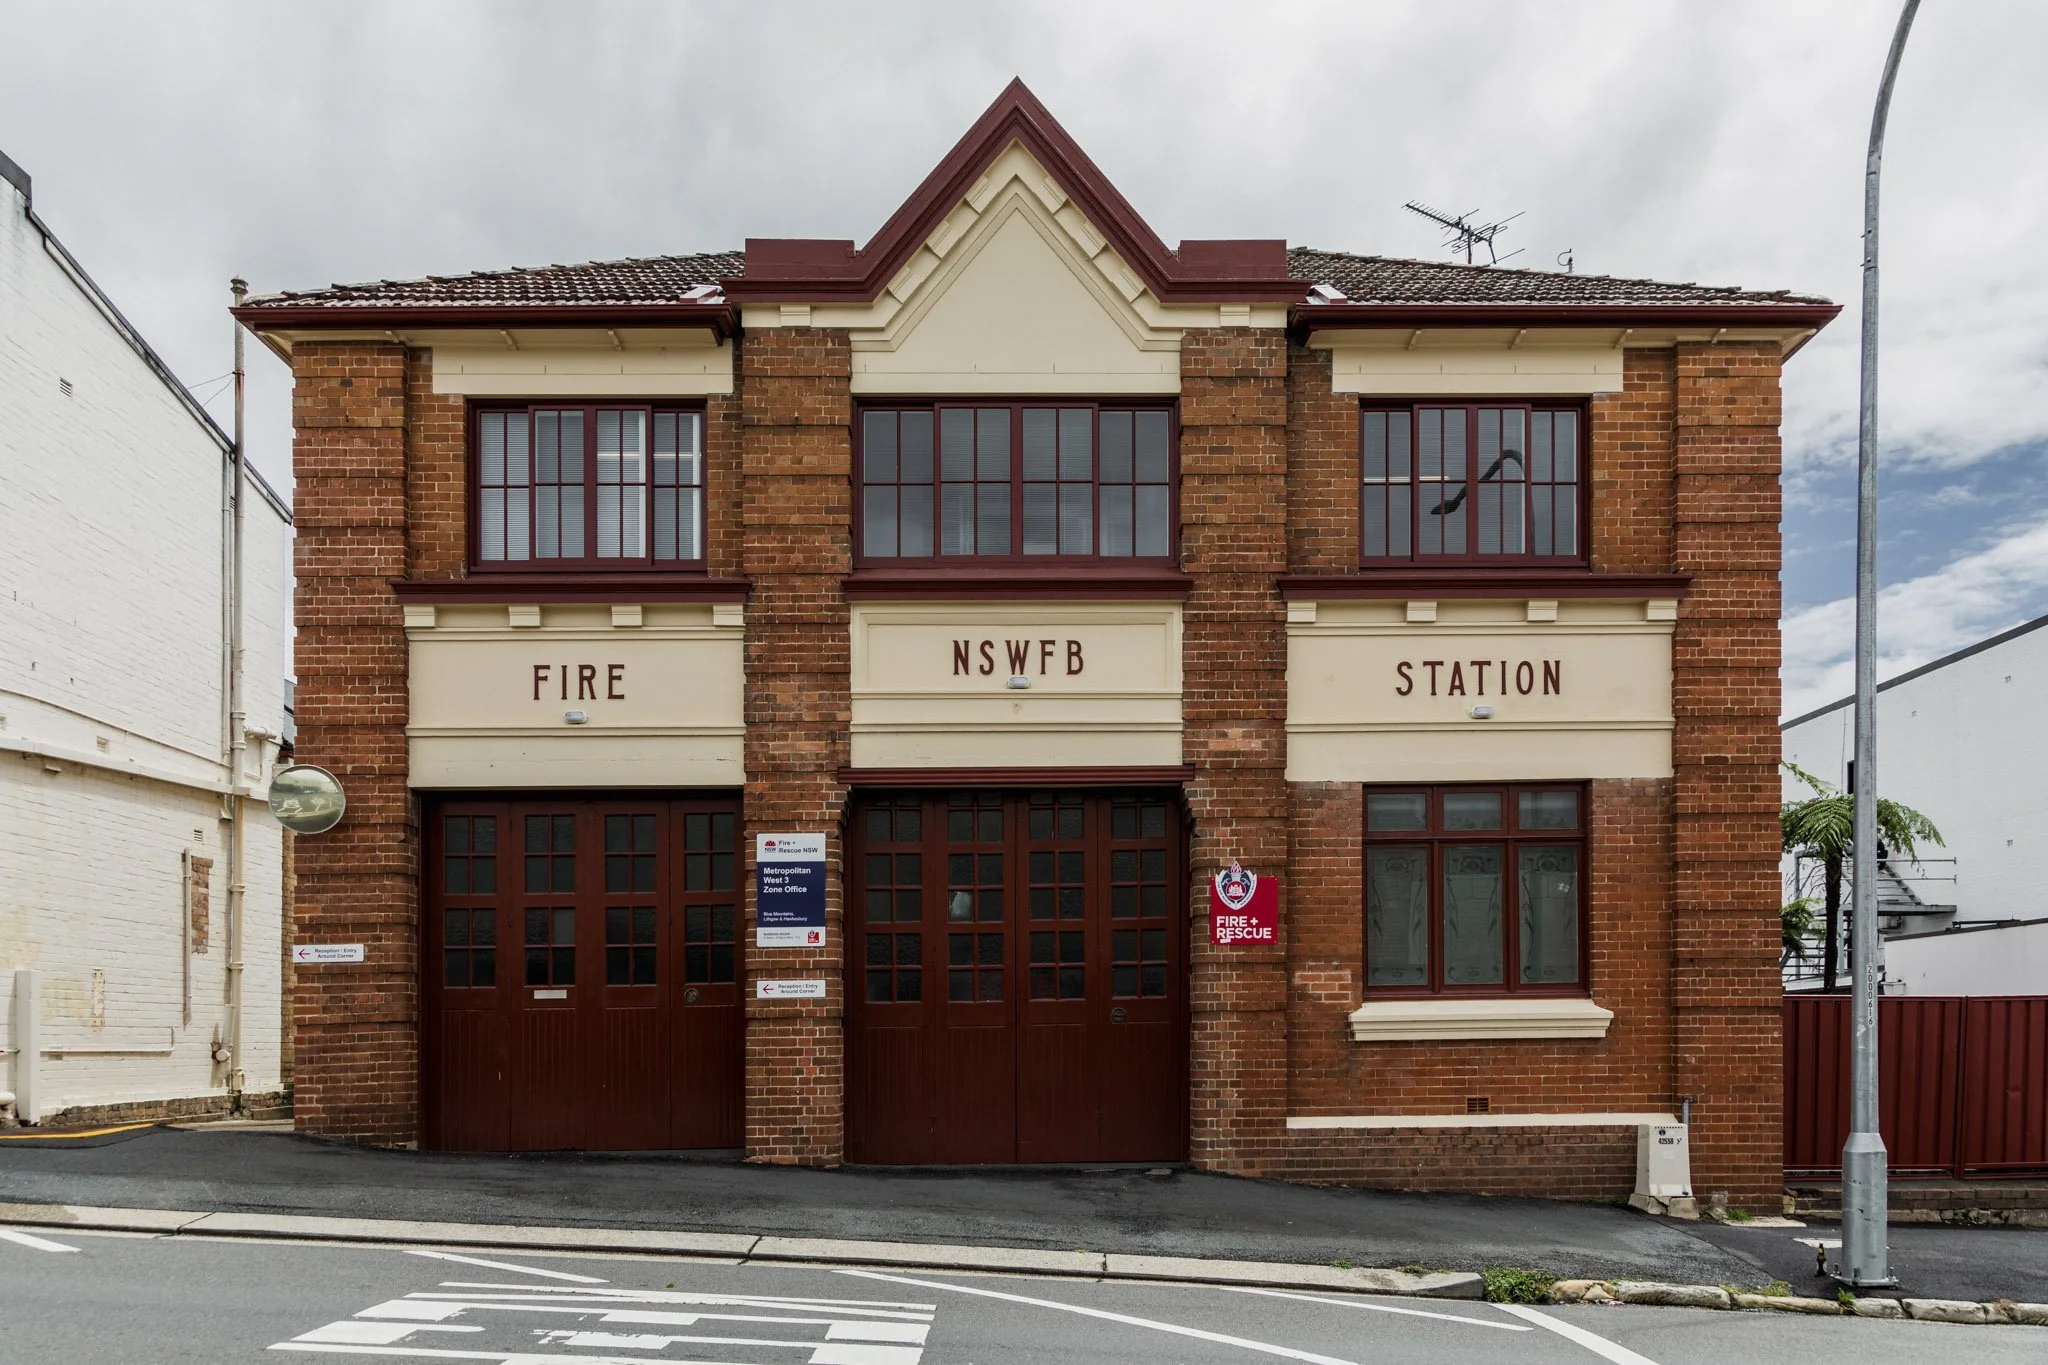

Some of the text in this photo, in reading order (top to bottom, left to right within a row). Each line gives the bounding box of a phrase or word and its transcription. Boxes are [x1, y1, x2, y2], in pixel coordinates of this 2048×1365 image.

[952, 639, 1084, 677] NSWFB
[532, 663, 625, 701] FIRE
[1395, 659, 1561, 697] STATION
[763, 867, 811, 875] Metropolitan
[763, 876, 790, 884] West 3
[763, 885, 807, 893] Zone Office
[1216, 916, 1259, 927] FIRE +
[1216, 927, 1272, 939] RESCUE
